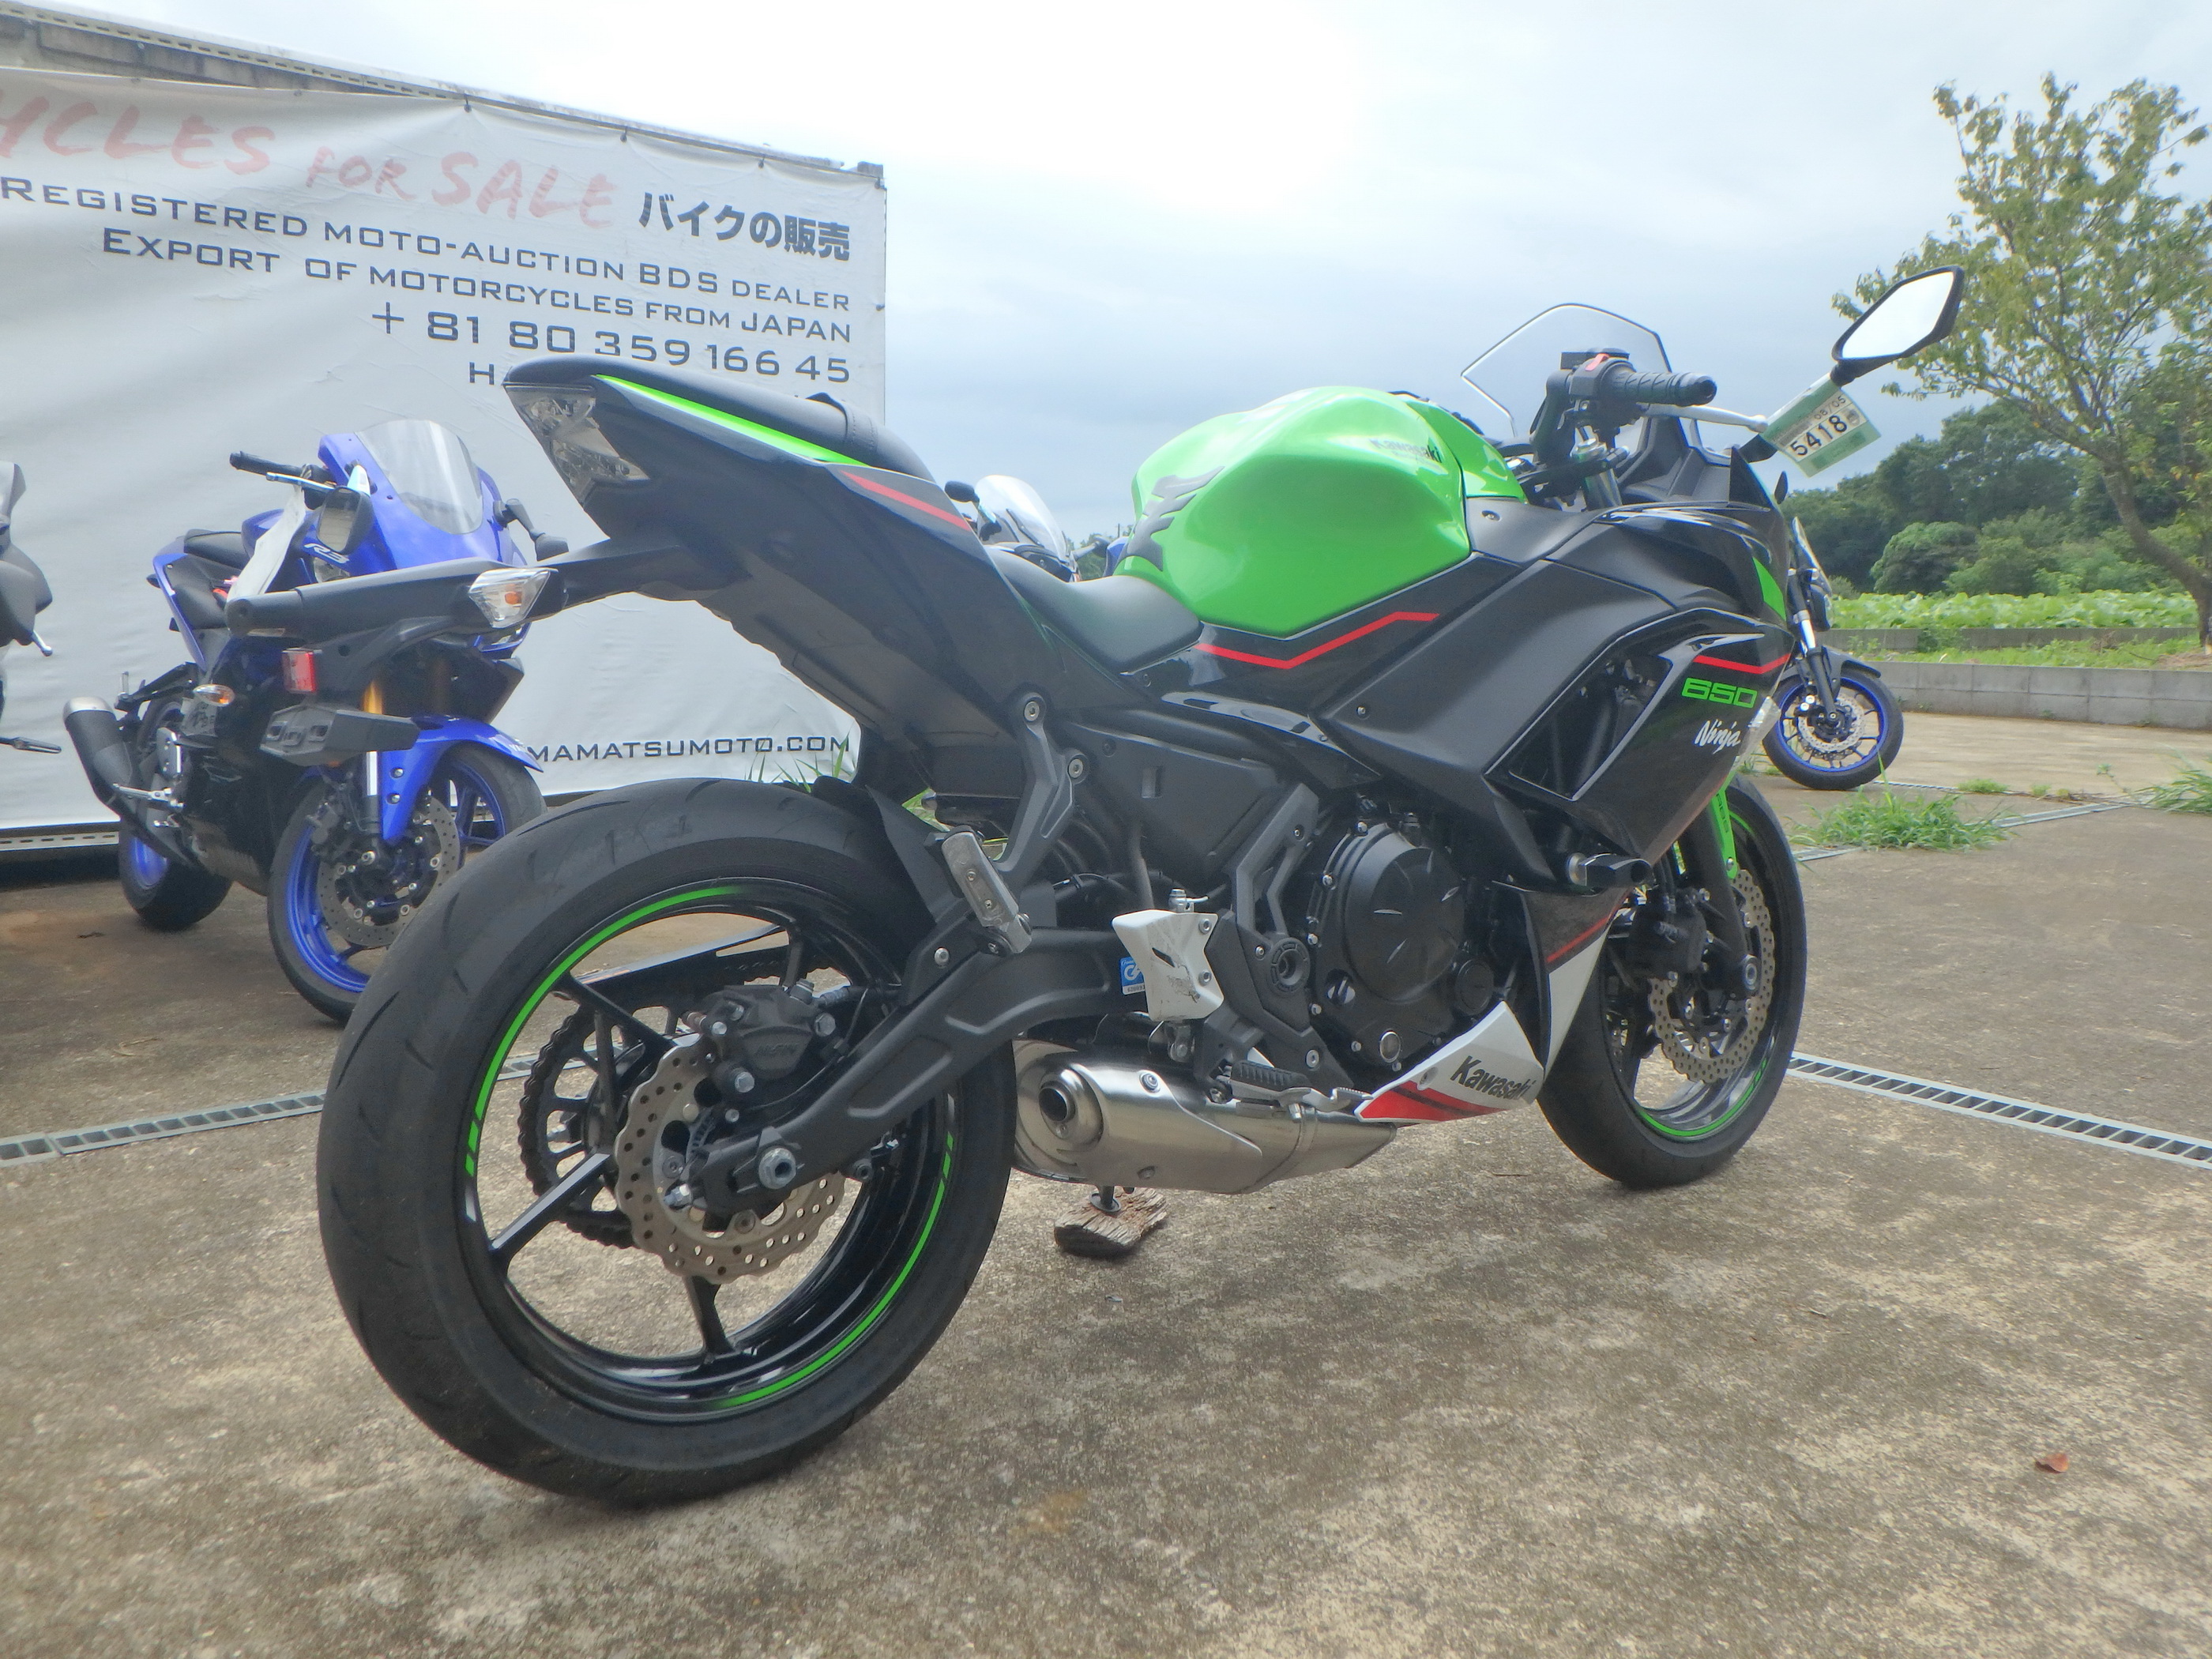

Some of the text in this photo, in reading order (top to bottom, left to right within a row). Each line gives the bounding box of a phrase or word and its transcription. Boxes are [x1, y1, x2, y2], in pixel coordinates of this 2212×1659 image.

[431, 151, 618, 228] SALE
[1, 176, 849, 311] REGISTERED MOTO-AUCTION BDS DEALER
[638, 191, 850, 261] バイクの販売
[103, 227, 850, 343] EXPORT OF MOTORCYCLES FROM JAPAN
[428, 311, 479, 344] 81
[510, 321, 576, 353] 80
[595, 331, 690, 366] 359
[706, 344, 780, 376] 166
[795, 356, 850, 383] 45
[1789, 415, 1848, 456] 5418
[1681, 677, 1758, 709] 650
[1694, 719, 1741, 755] Ninja
[1450, 1055, 1537, 1100] Kawasaki
